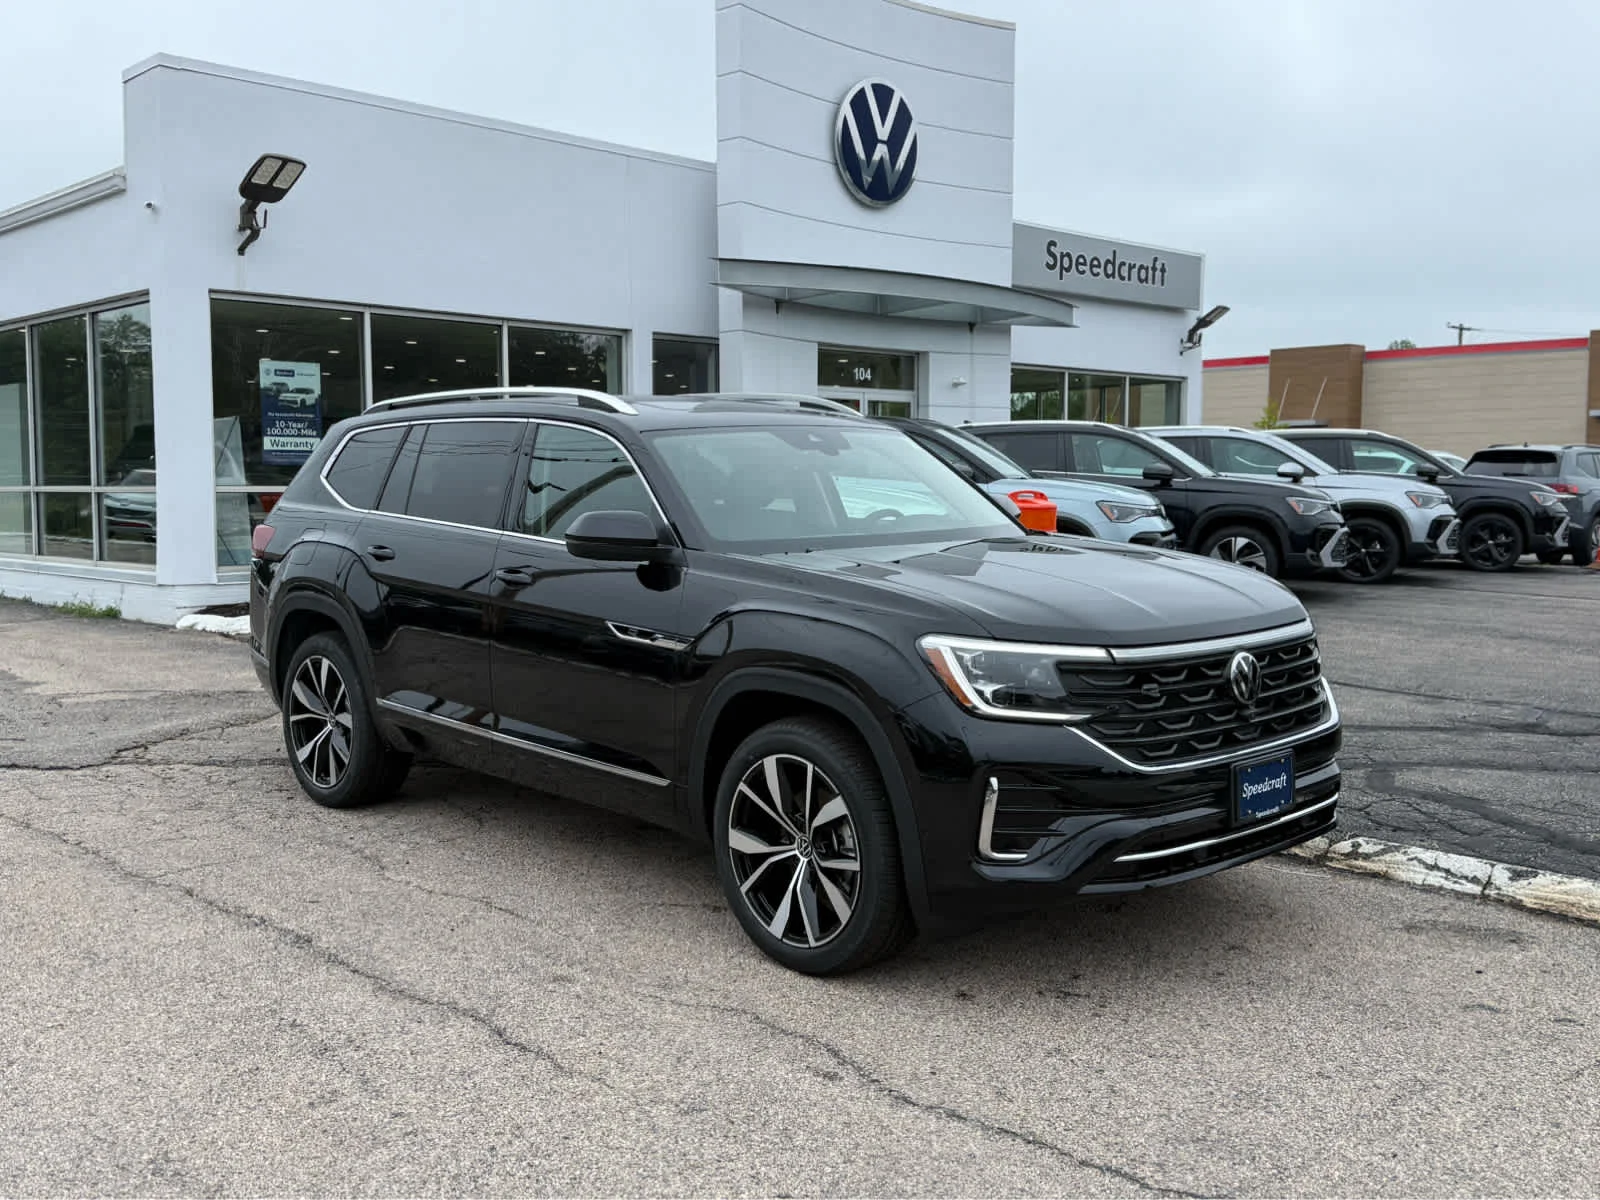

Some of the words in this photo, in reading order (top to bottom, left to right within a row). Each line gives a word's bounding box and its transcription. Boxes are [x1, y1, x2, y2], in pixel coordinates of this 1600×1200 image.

[1045, 239, 1167, 287] Speedcraft
[853, 367, 872, 381] 104
[270, 439, 314, 450] Warranty
[1241, 772, 1287, 800] Speedcraft
